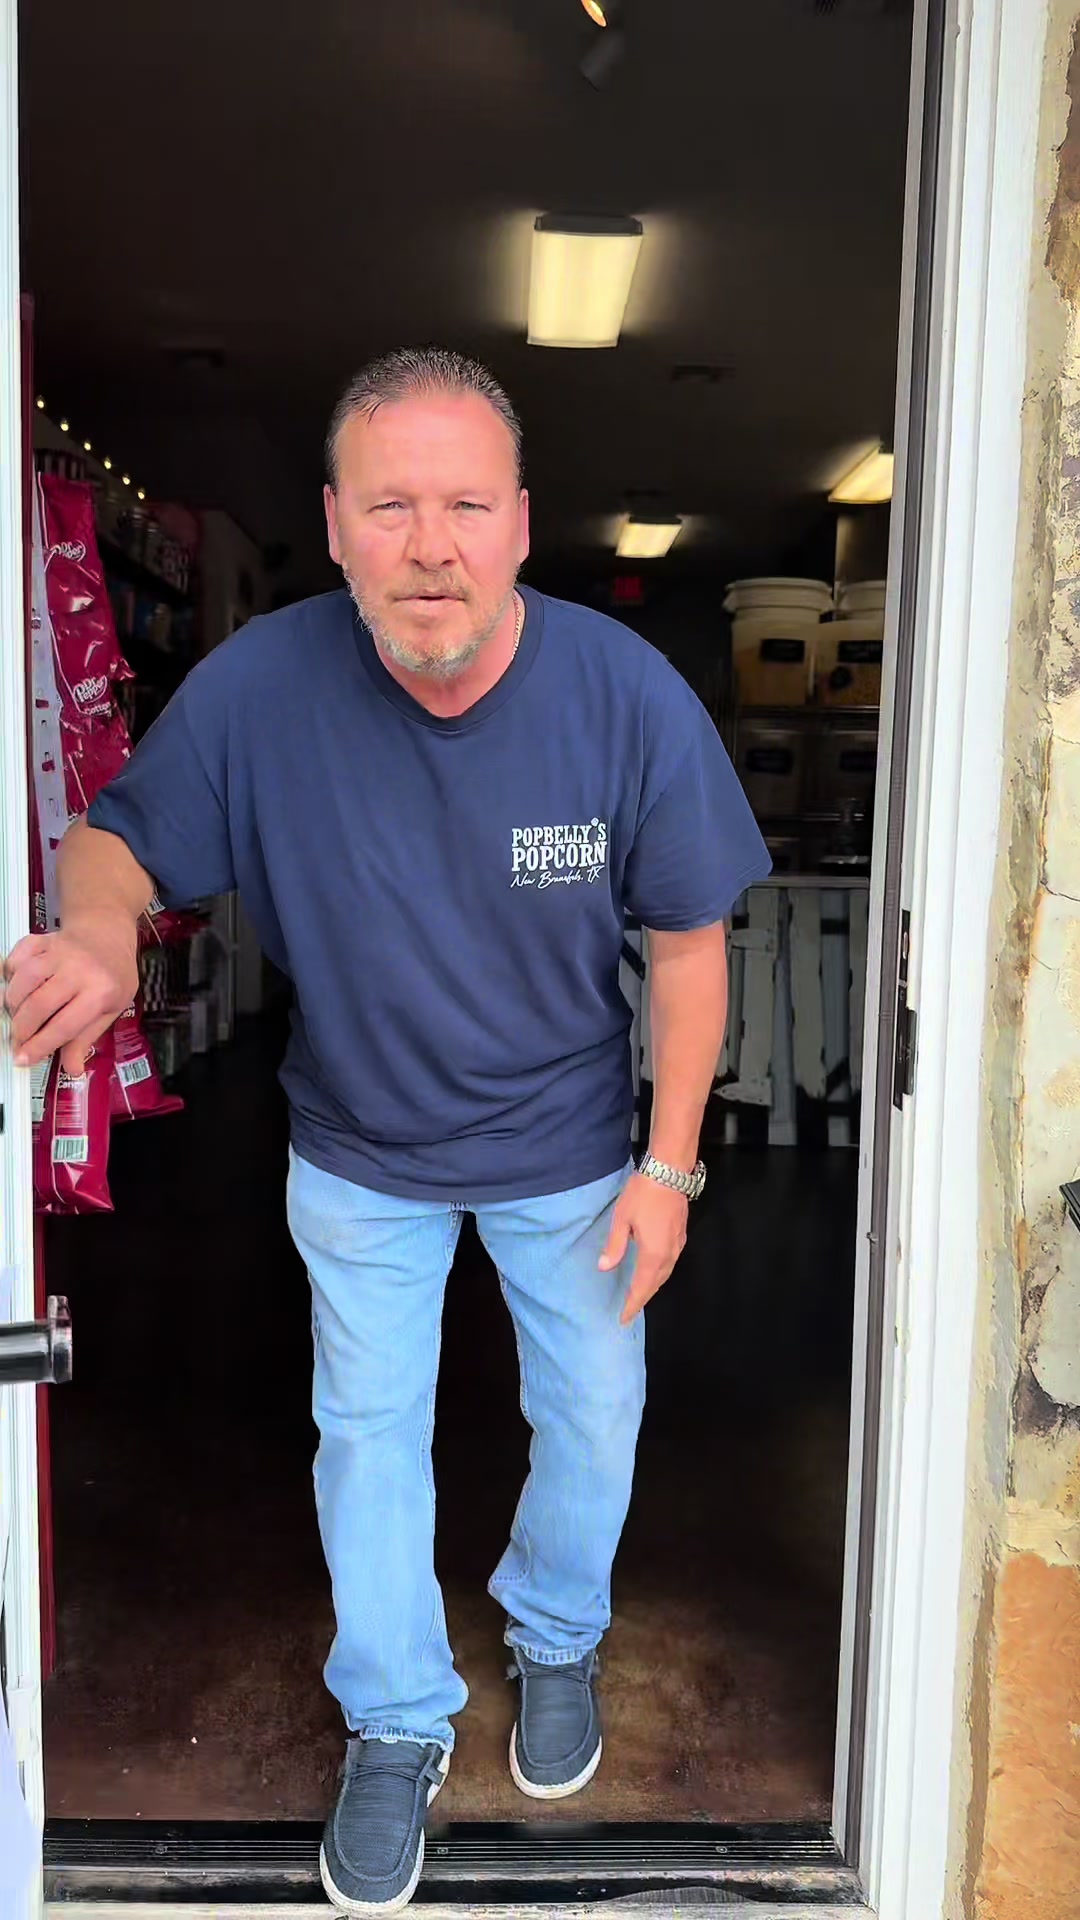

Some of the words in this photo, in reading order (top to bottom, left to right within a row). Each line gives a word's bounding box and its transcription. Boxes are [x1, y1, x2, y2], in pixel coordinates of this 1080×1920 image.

[511, 817, 607, 847] POPBELLY'S
[511, 841, 607, 872] POPCORN
[510, 872, 536, 888] New
[586, 865, 604, 883] TX
